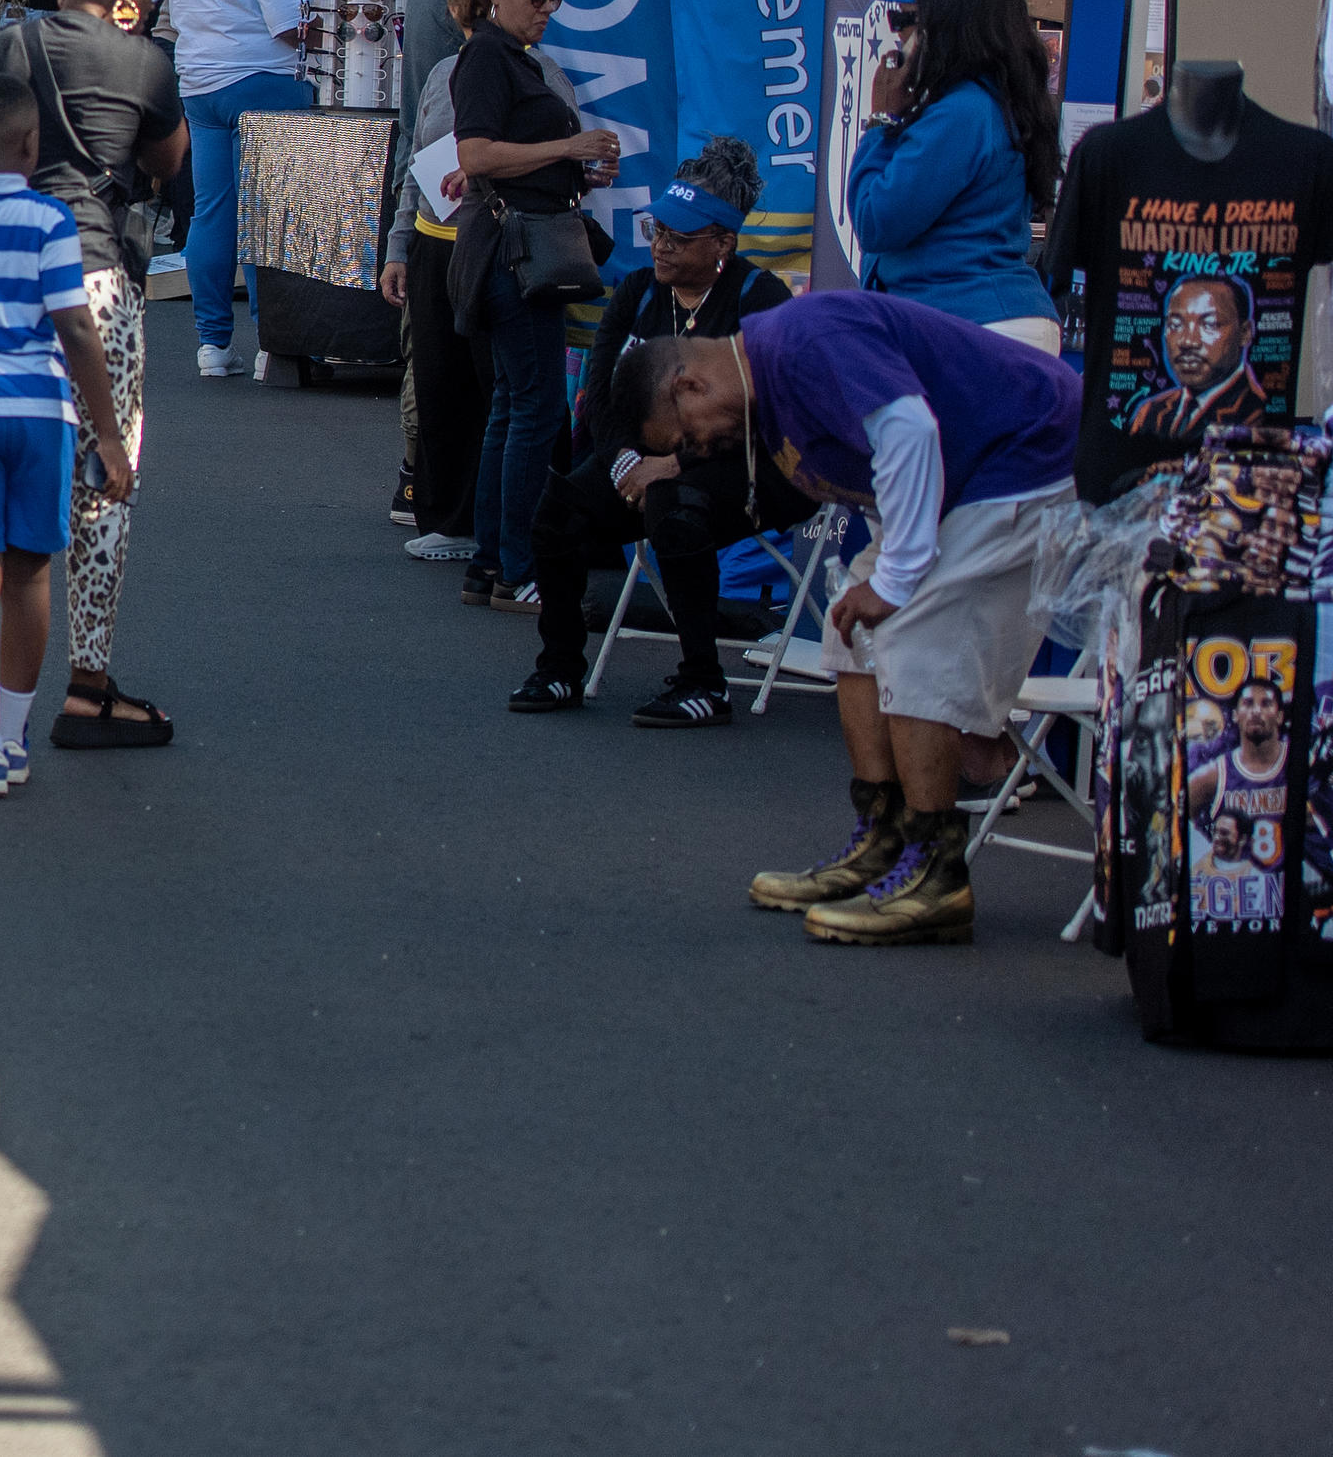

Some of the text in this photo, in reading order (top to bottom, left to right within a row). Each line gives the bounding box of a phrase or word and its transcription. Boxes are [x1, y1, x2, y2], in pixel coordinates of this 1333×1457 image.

[1125, 196, 1295, 224] I HAVE A DREAM
[1119, 220, 1299, 256] MARTIN LUTHER
[1162, 249, 1260, 276] KING JR.
[1251, 818, 1282, 869] 8
[1232, 918, 1281, 934] FOR
